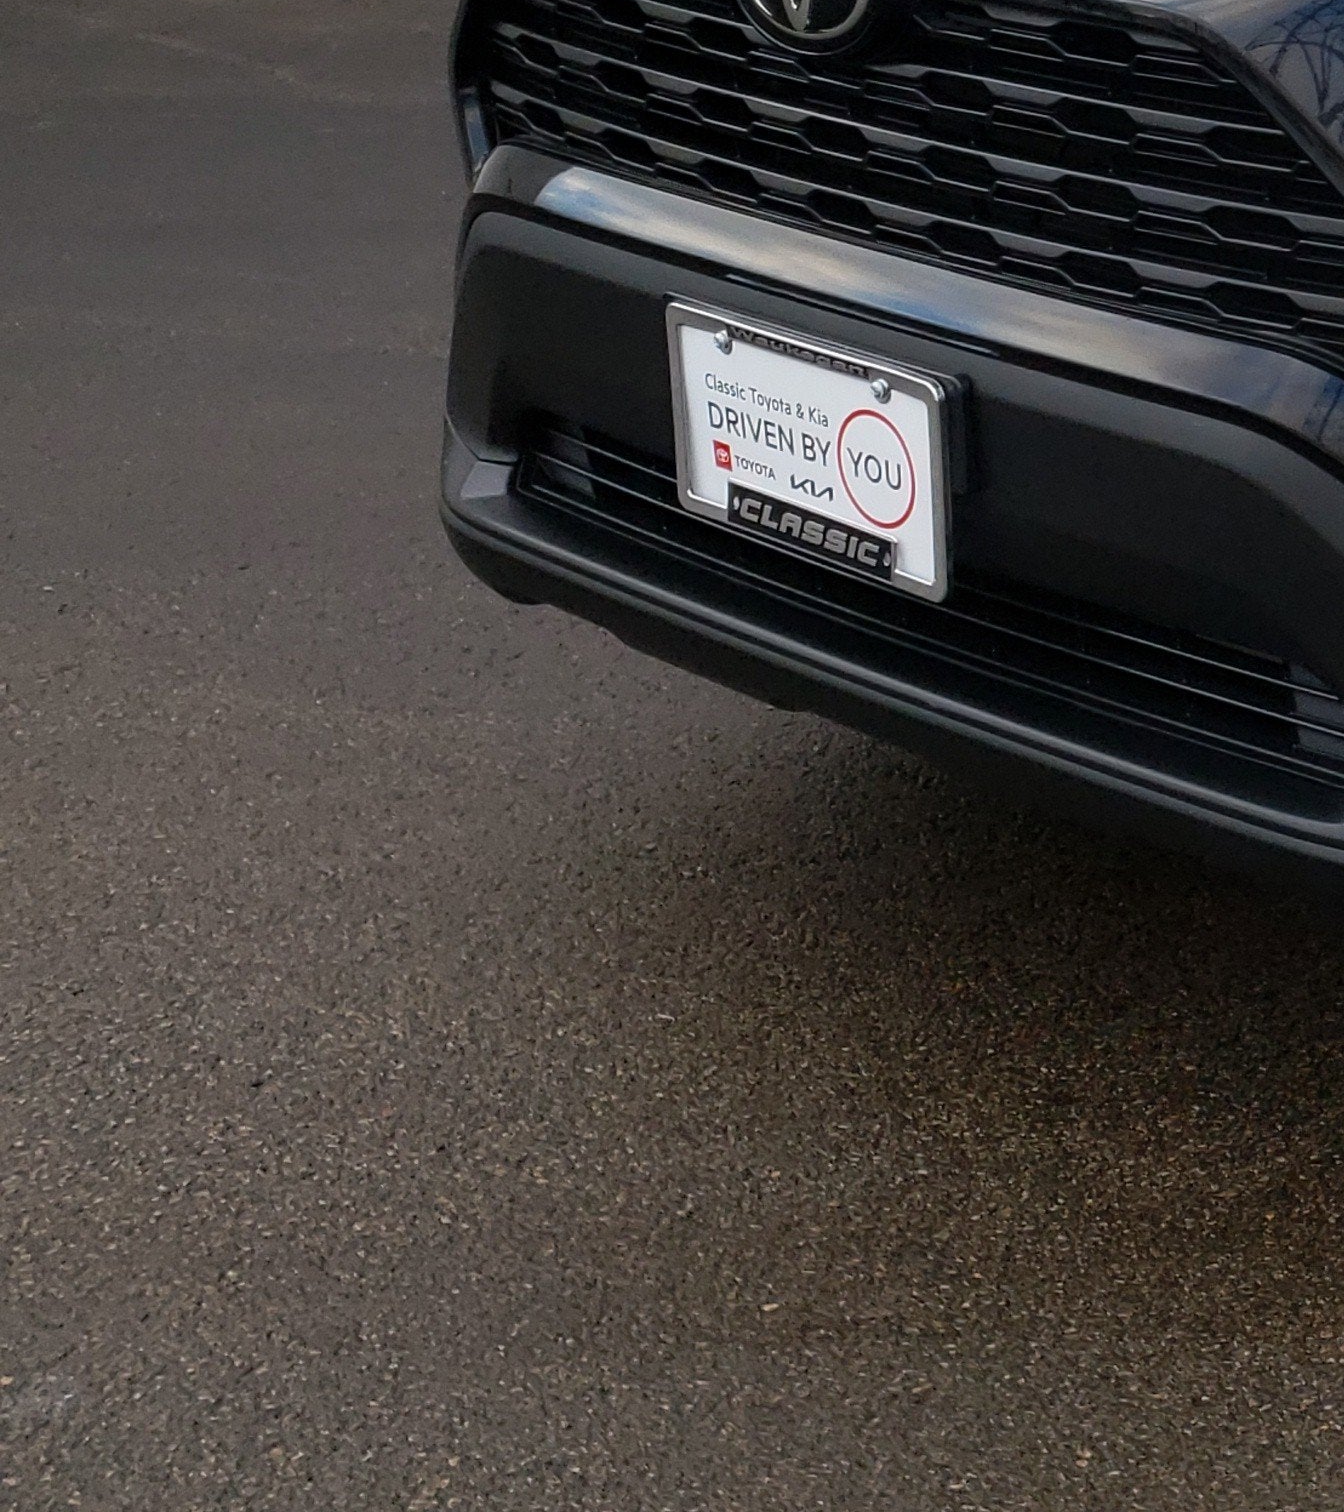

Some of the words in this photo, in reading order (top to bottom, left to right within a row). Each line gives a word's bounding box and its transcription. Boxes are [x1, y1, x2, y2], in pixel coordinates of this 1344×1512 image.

[705, 373, 746, 401] Classic
[748, 387, 792, 416] Toyota
[796, 403, 804, 420] &
[808, 406, 829, 428] Kia
[708, 400, 795, 456] DRIVEN
[802, 432, 831, 467] BY
[735, 454, 776, 480] TOYOTA
[847, 447, 901, 490] YOU
[739, 498, 880, 567] CLASSIC
